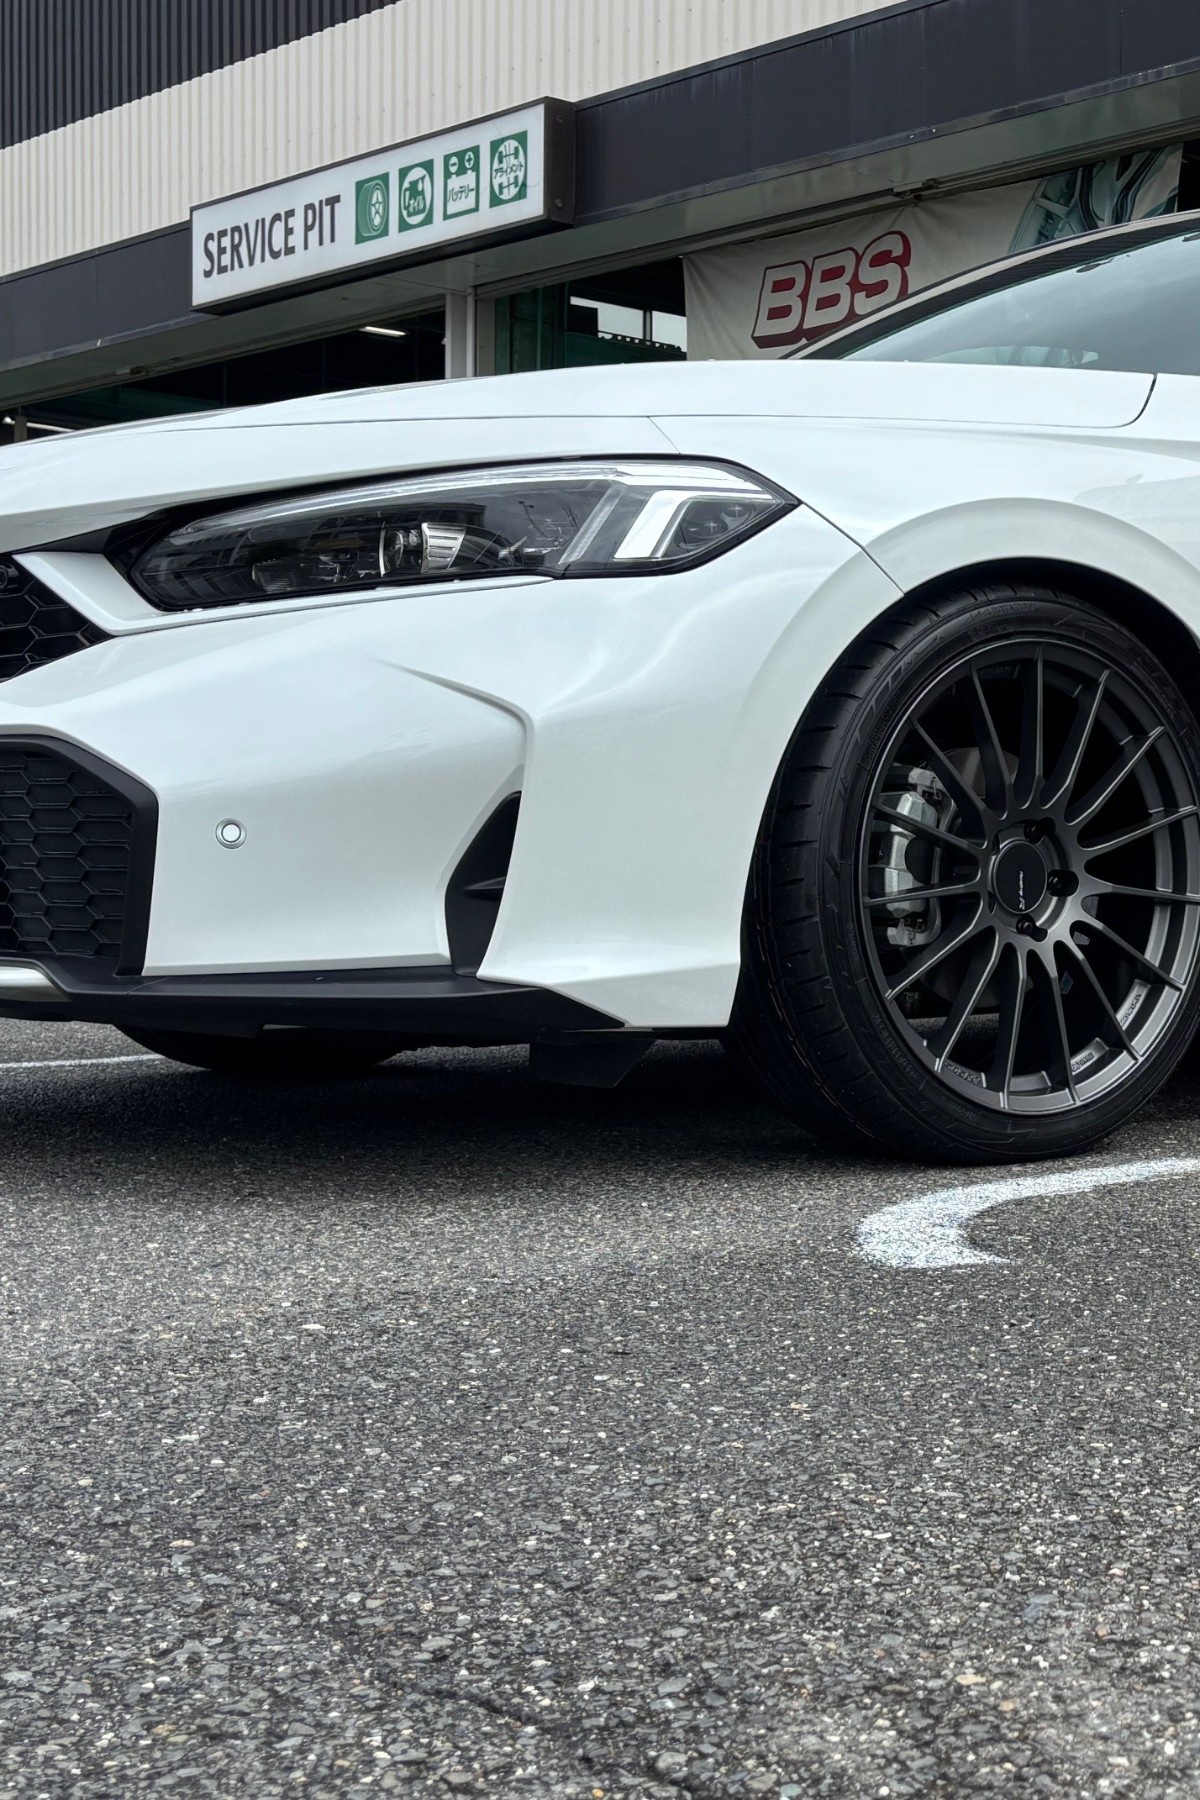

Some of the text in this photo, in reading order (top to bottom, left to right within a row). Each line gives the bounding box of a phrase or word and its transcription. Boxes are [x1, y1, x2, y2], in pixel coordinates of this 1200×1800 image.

[494, 161, 524, 179] アライメント
[448, 183, 475, 203] バッテリー
[408, 194, 425, 213] オイル
[203, 194, 341, 279] SERVICE PIT
[751, 230, 911, 349] BBS
